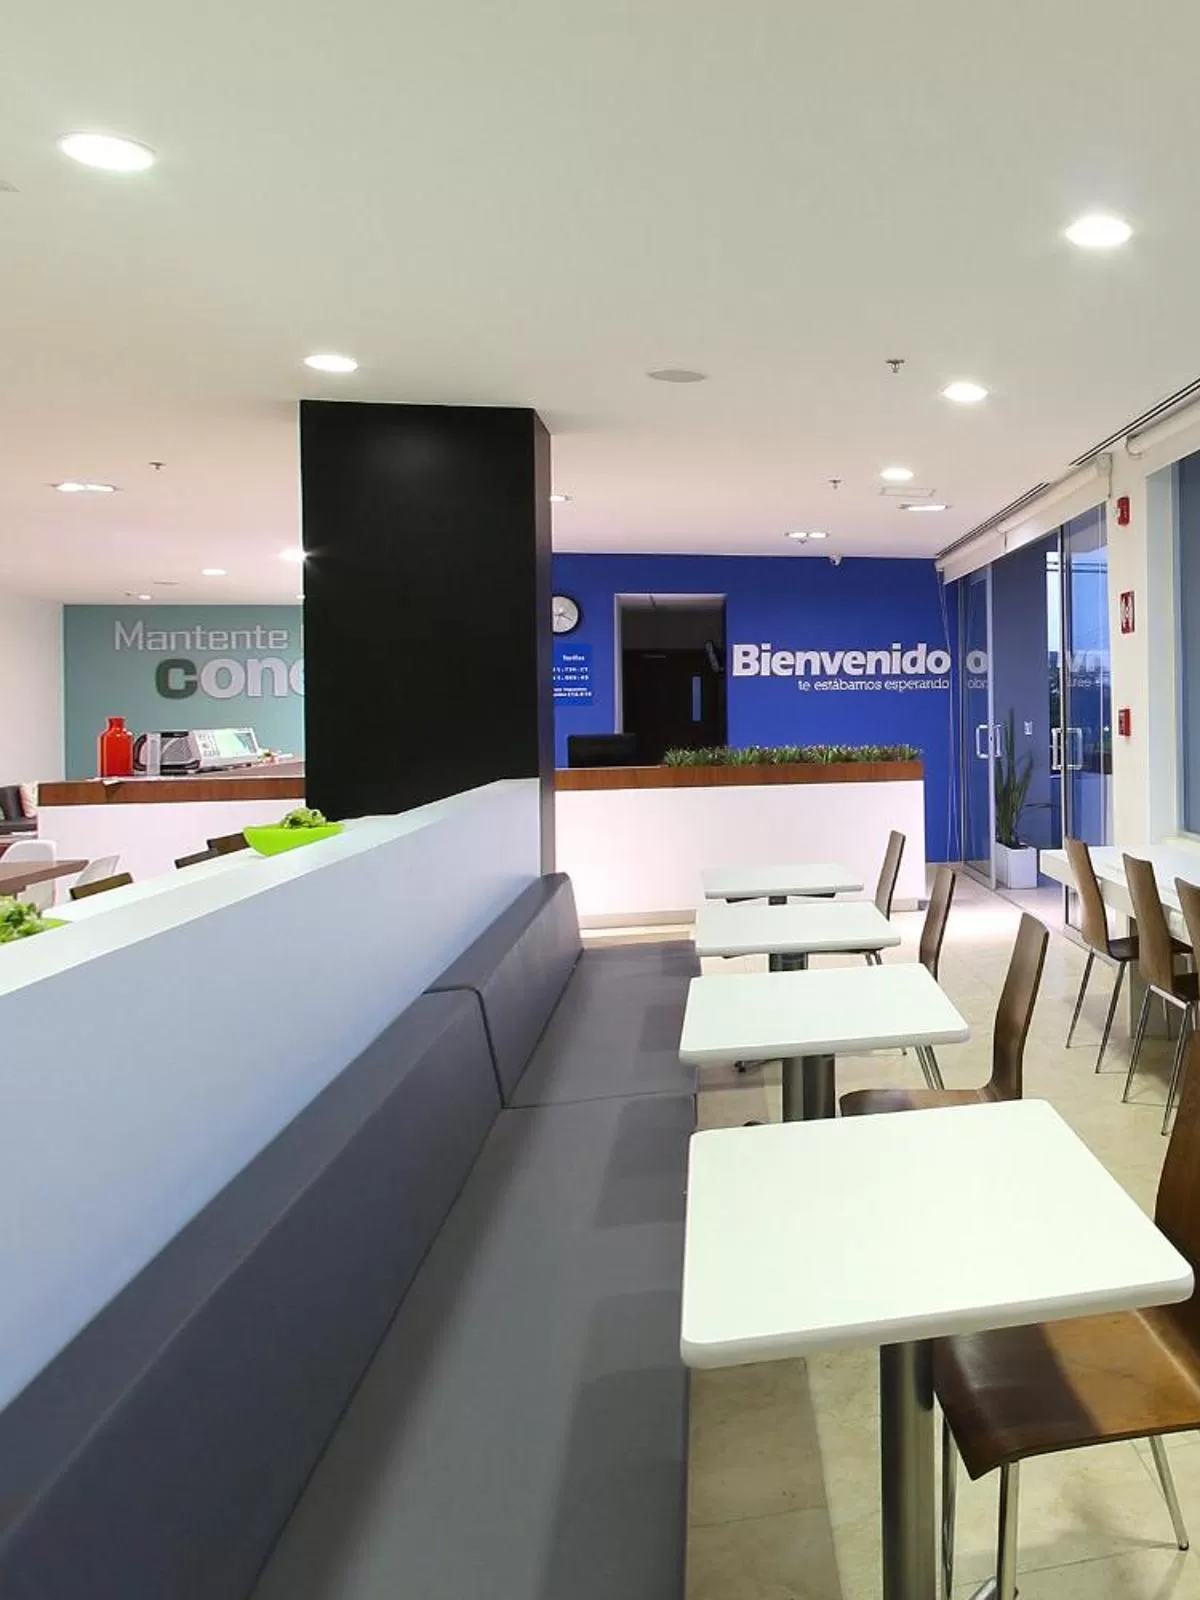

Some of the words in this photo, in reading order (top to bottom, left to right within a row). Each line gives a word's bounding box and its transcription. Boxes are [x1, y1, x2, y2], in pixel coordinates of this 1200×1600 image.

[114, 619, 289, 651] Mantente
[732, 643, 951, 676] Bienvenido
[798, 679, 811, 691] te
[814, 678, 882, 691] estábamos
[884, 678, 949, 693] esperando
